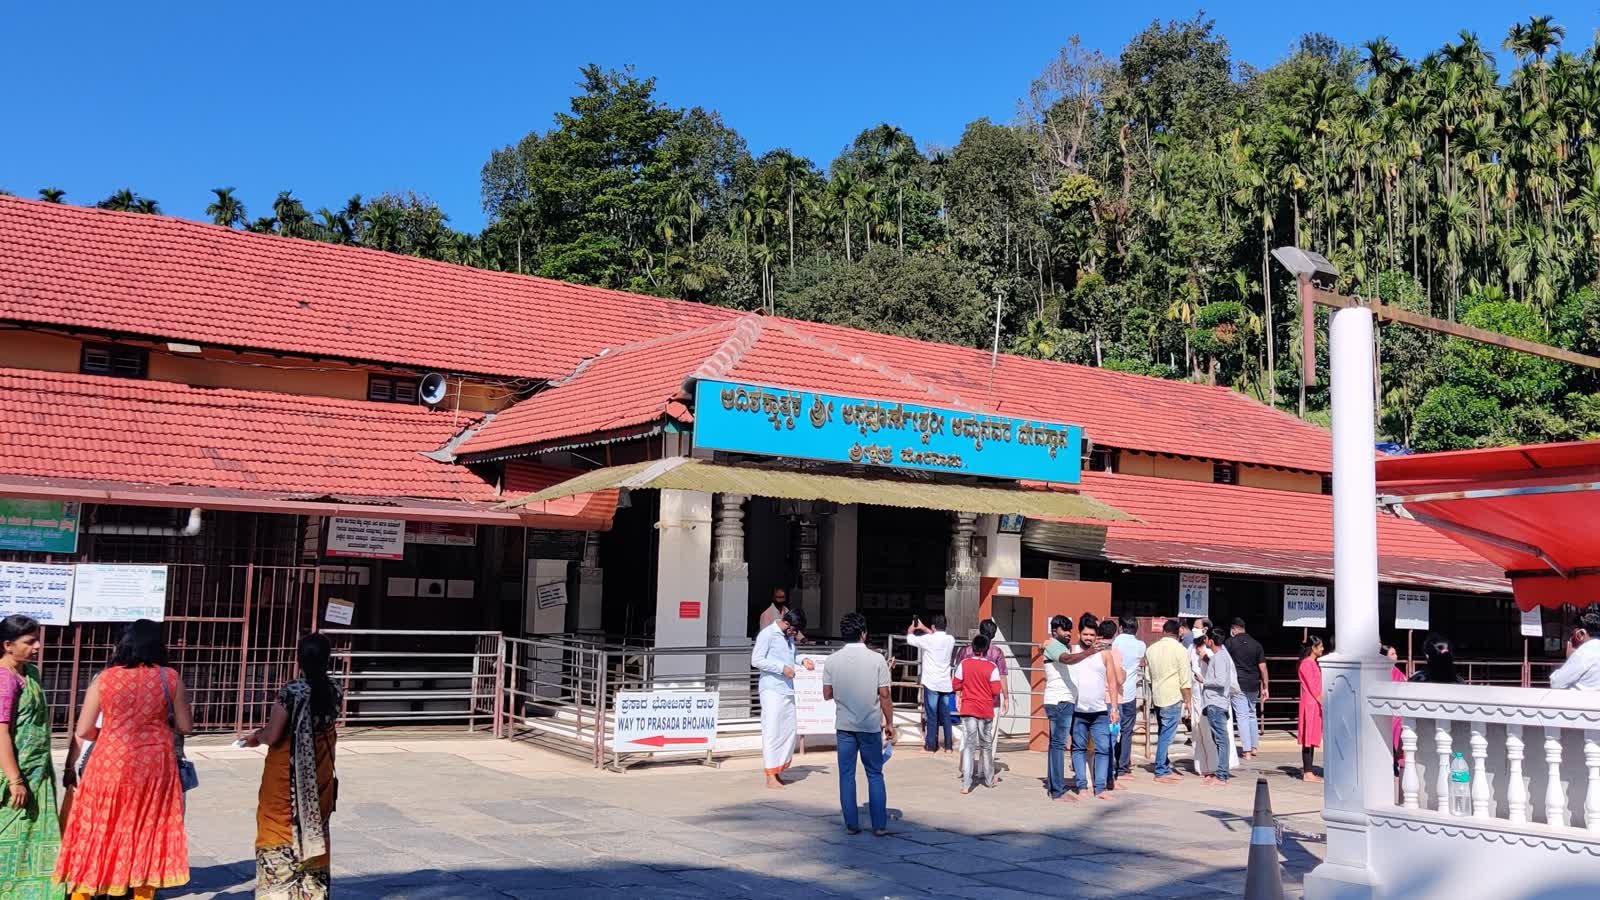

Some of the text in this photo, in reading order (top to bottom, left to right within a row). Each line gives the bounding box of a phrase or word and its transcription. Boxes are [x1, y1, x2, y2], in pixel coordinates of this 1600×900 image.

[809, 391, 834, 428] ಶ್ರೀ
[951, 415, 1012, 451] ಅಮ್ಮನವರ
[1017, 422, 1069, 459] ದೇವಸ್ಥಾನ
[1287, 600, 1325, 611] WAY TO DARSHAN
[621, 696, 715, 714] ಪ್ರಸಾದ ಭೋಜನಕ್ಕೆ ದಾರಿ
[618, 716, 715, 731] WAY TO PRASADA BHOJANA
